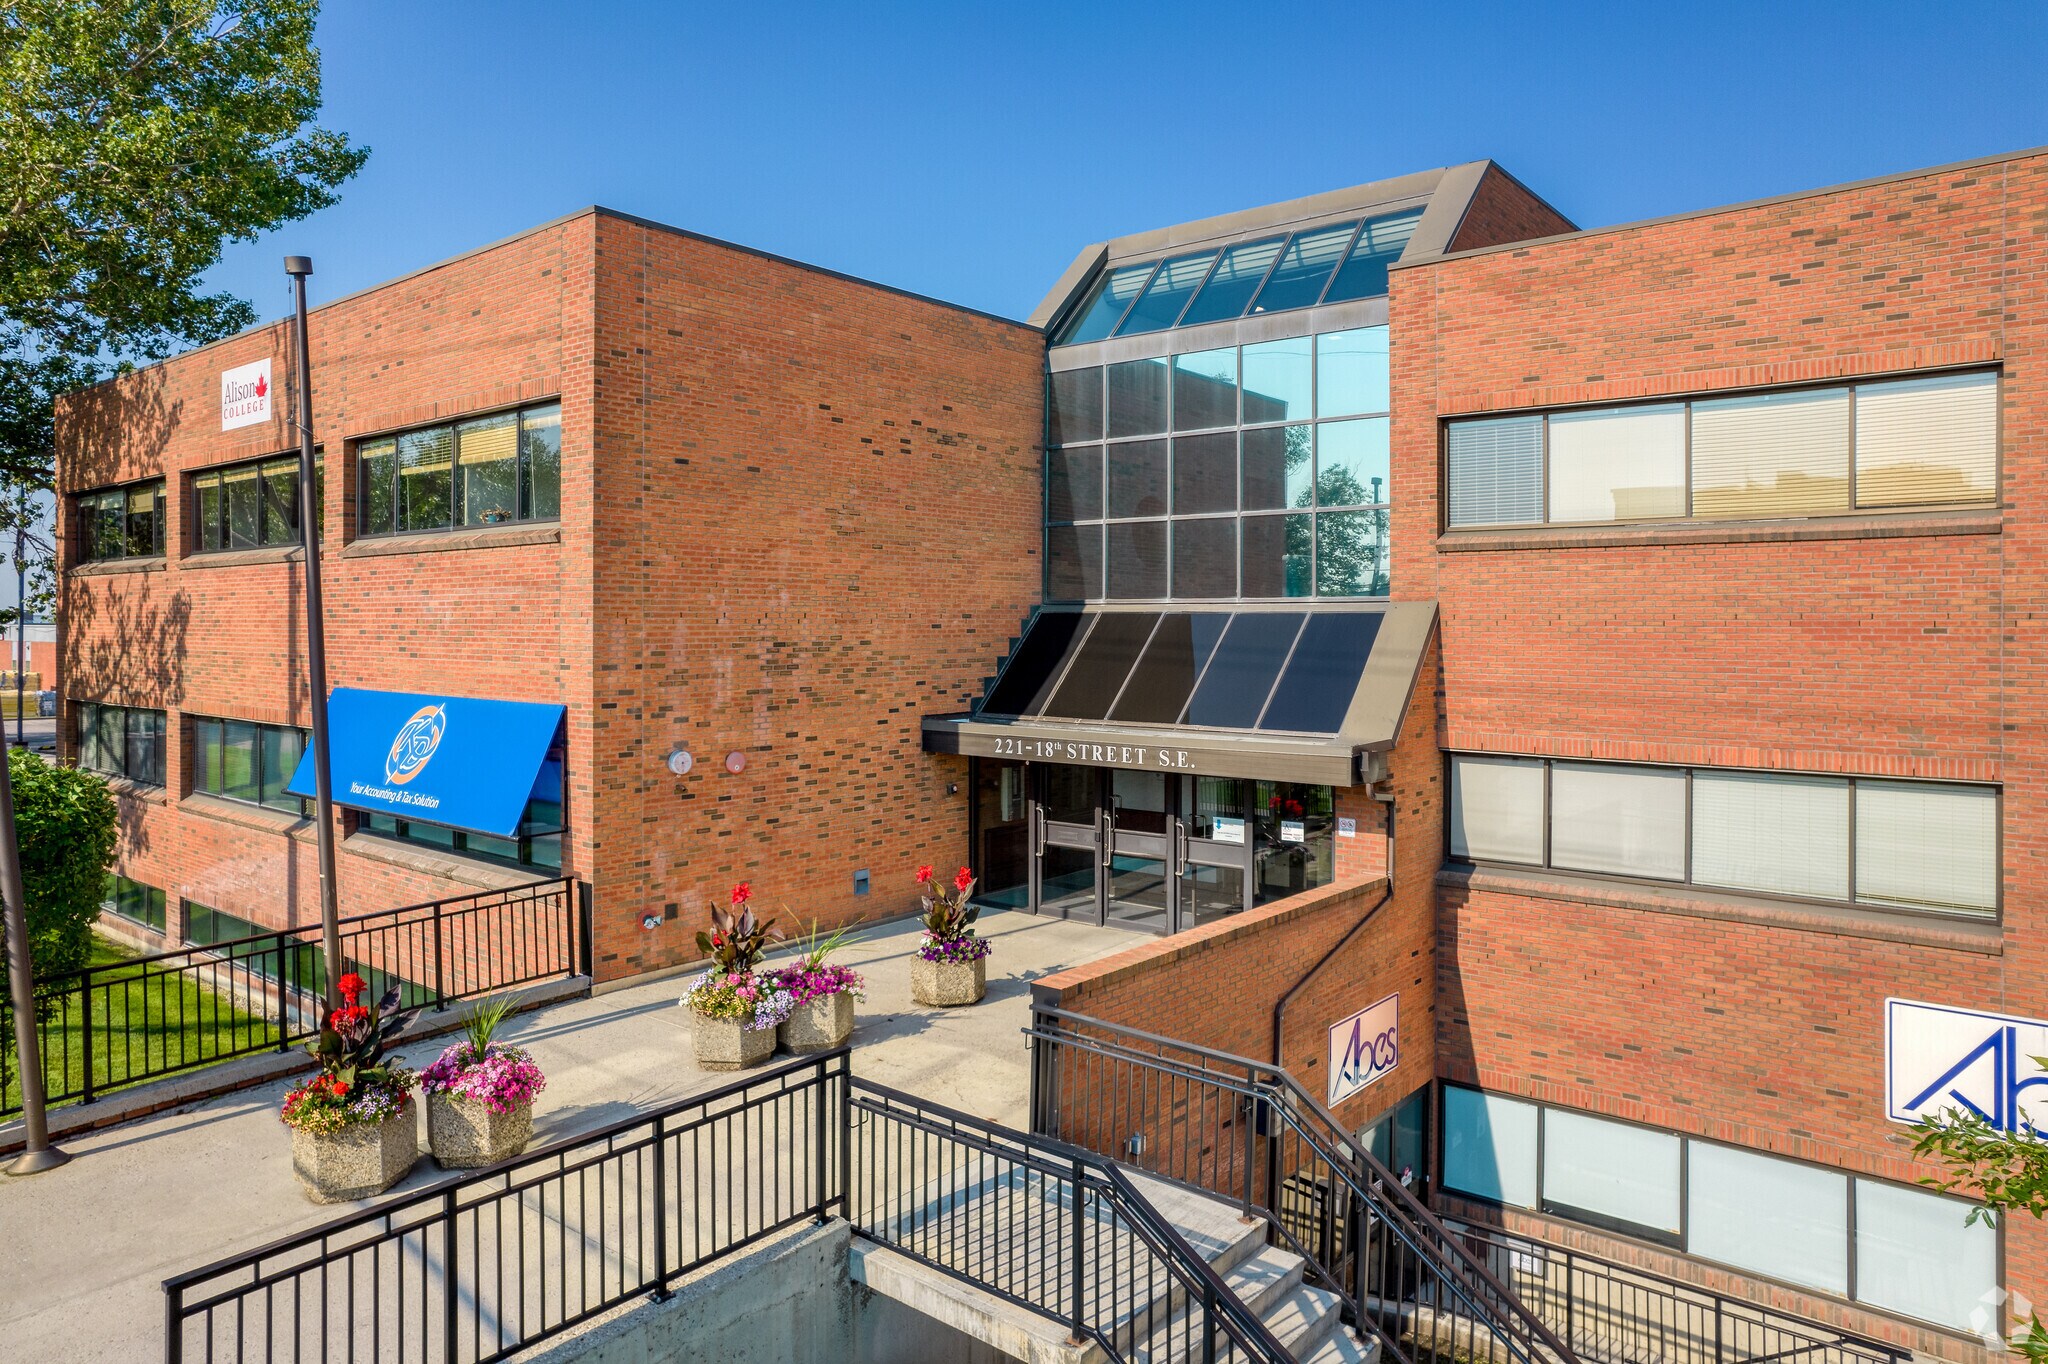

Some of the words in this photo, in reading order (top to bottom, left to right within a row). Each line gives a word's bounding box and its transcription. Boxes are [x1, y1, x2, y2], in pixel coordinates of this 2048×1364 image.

[224, 381, 256, 404] Alison
[223, 399, 265, 419] COLLEGE
[1066, 743, 1147, 765] STREET
[1158, 749, 1196, 769] S.E.
[350, 781, 365, 794] Your
[362, 784, 397, 803] Accounting
[395, 790, 402, 802] &
[402, 791, 414, 804] Tax
[412, 793, 440, 809] Solution
[1332, 1017, 1396, 1098] Abcs
